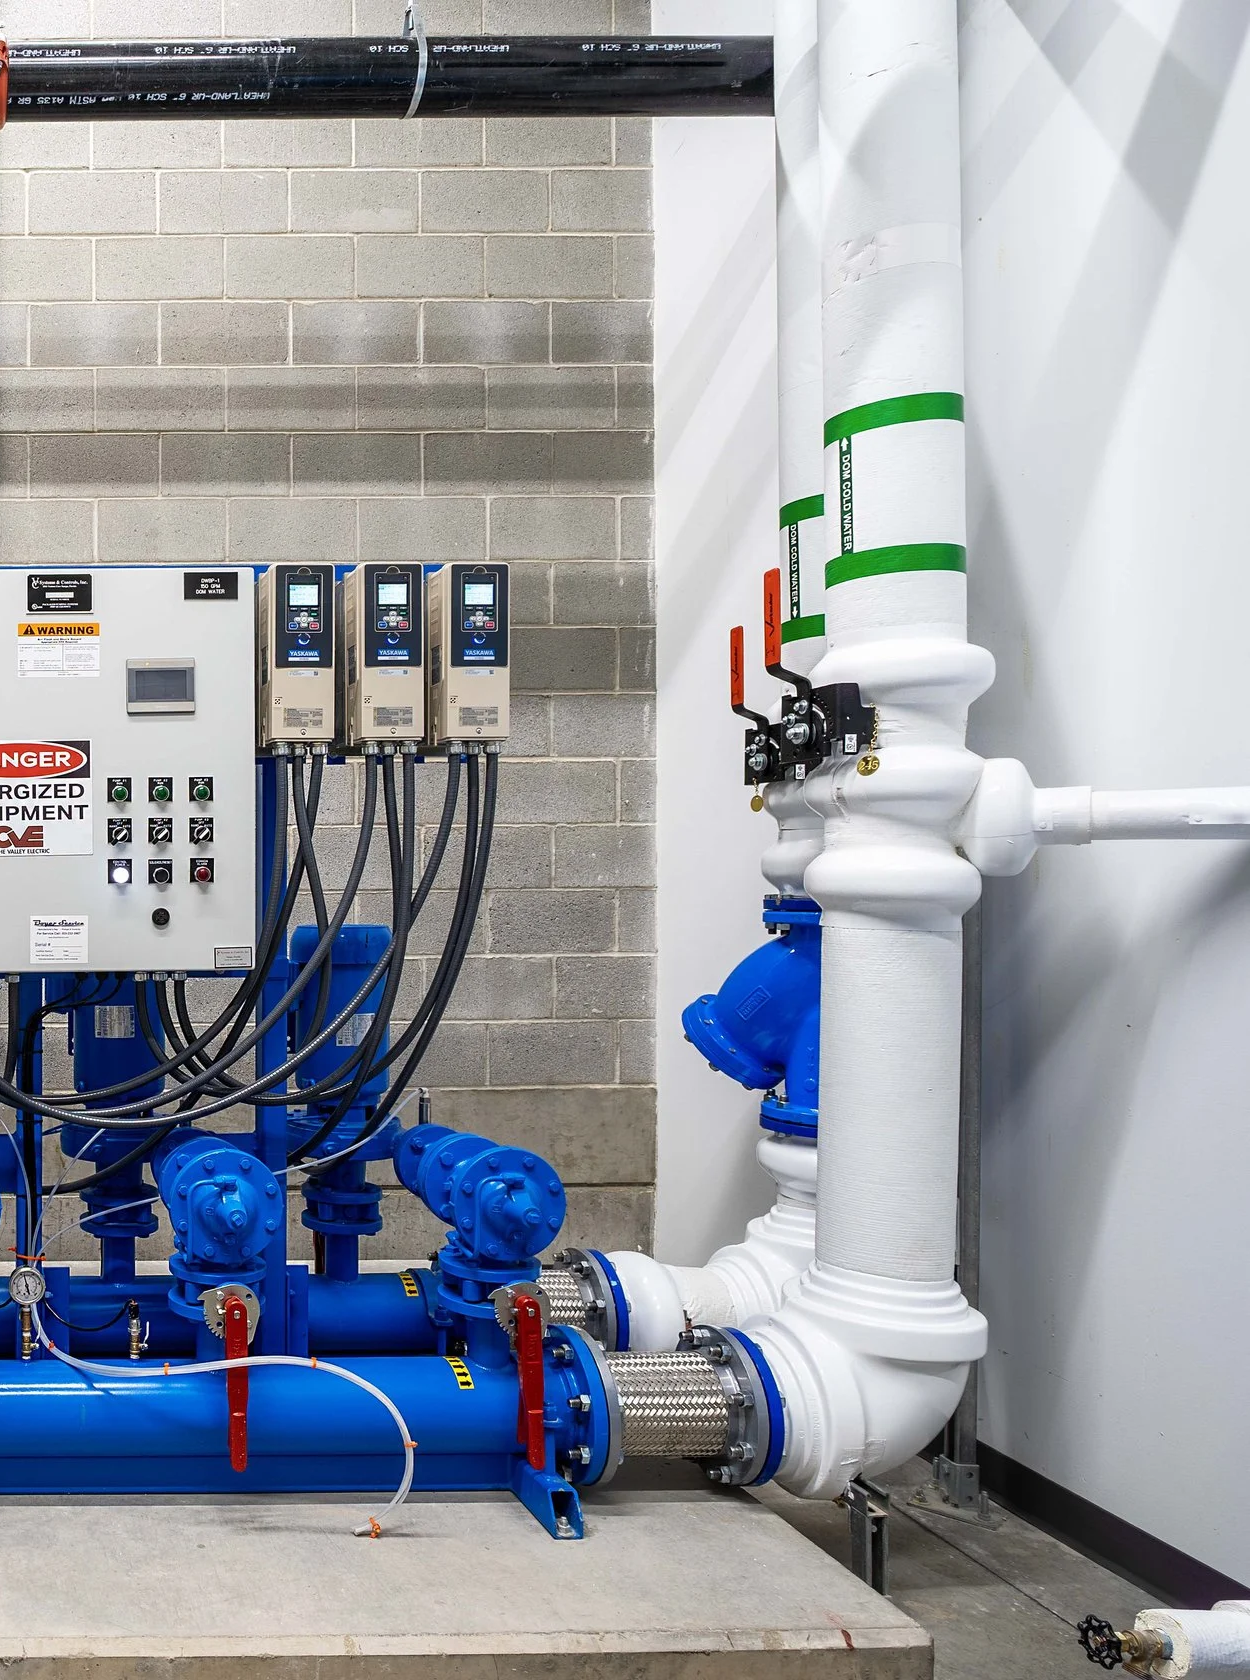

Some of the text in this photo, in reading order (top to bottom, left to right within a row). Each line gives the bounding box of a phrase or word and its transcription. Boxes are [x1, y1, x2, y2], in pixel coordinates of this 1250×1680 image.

[601, 43, 621, 51] SCH
[16, 97, 31, 105] GR
[38, 97, 63, 105] A135
[70, 95, 96, 105] ASTM
[145, 93, 167, 101] SCH
[841, 454, 853, 551] DOM COLD WATER
[37, 626, 94, 634] WARNING
[858, 760, 878, 770] 245
